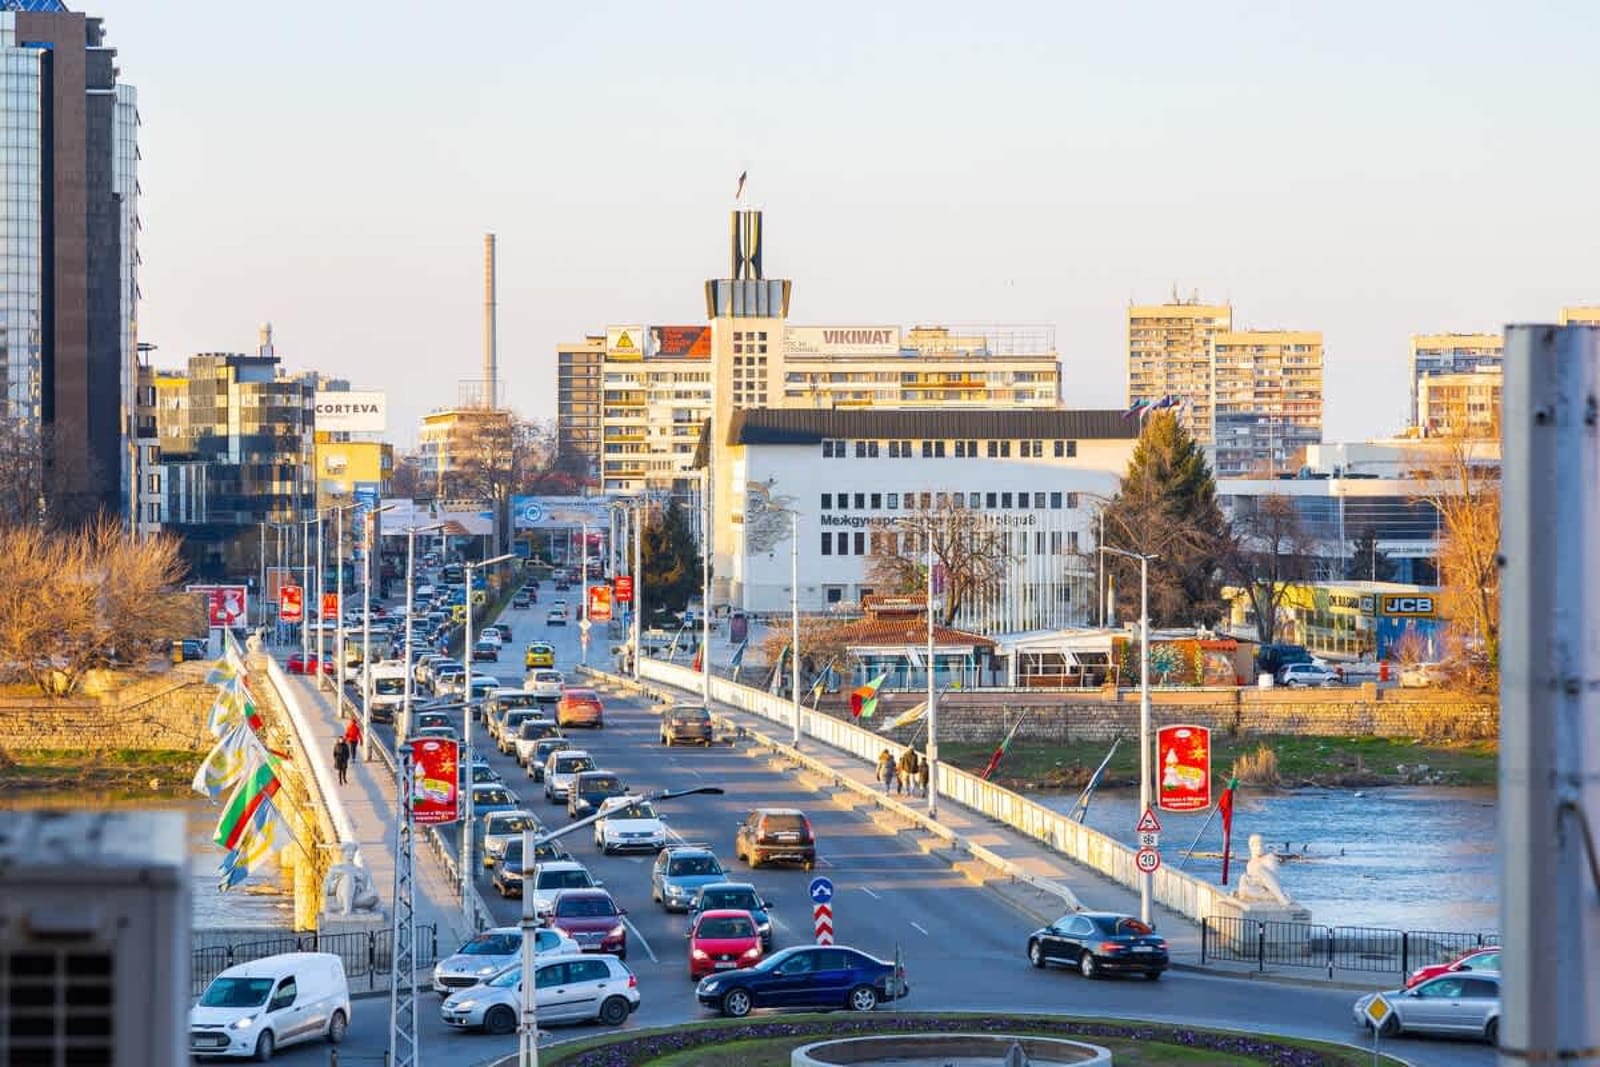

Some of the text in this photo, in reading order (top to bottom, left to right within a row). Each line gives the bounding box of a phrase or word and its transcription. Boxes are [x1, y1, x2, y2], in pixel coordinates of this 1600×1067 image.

[823, 329, 893, 345] VIKIWAT
[315, 403, 379, 414] CORTEVA
[820, 514, 922, 529] Междунаро
[1385, 597, 1433, 612] JCB
[1141, 854, 1156, 867] 30
